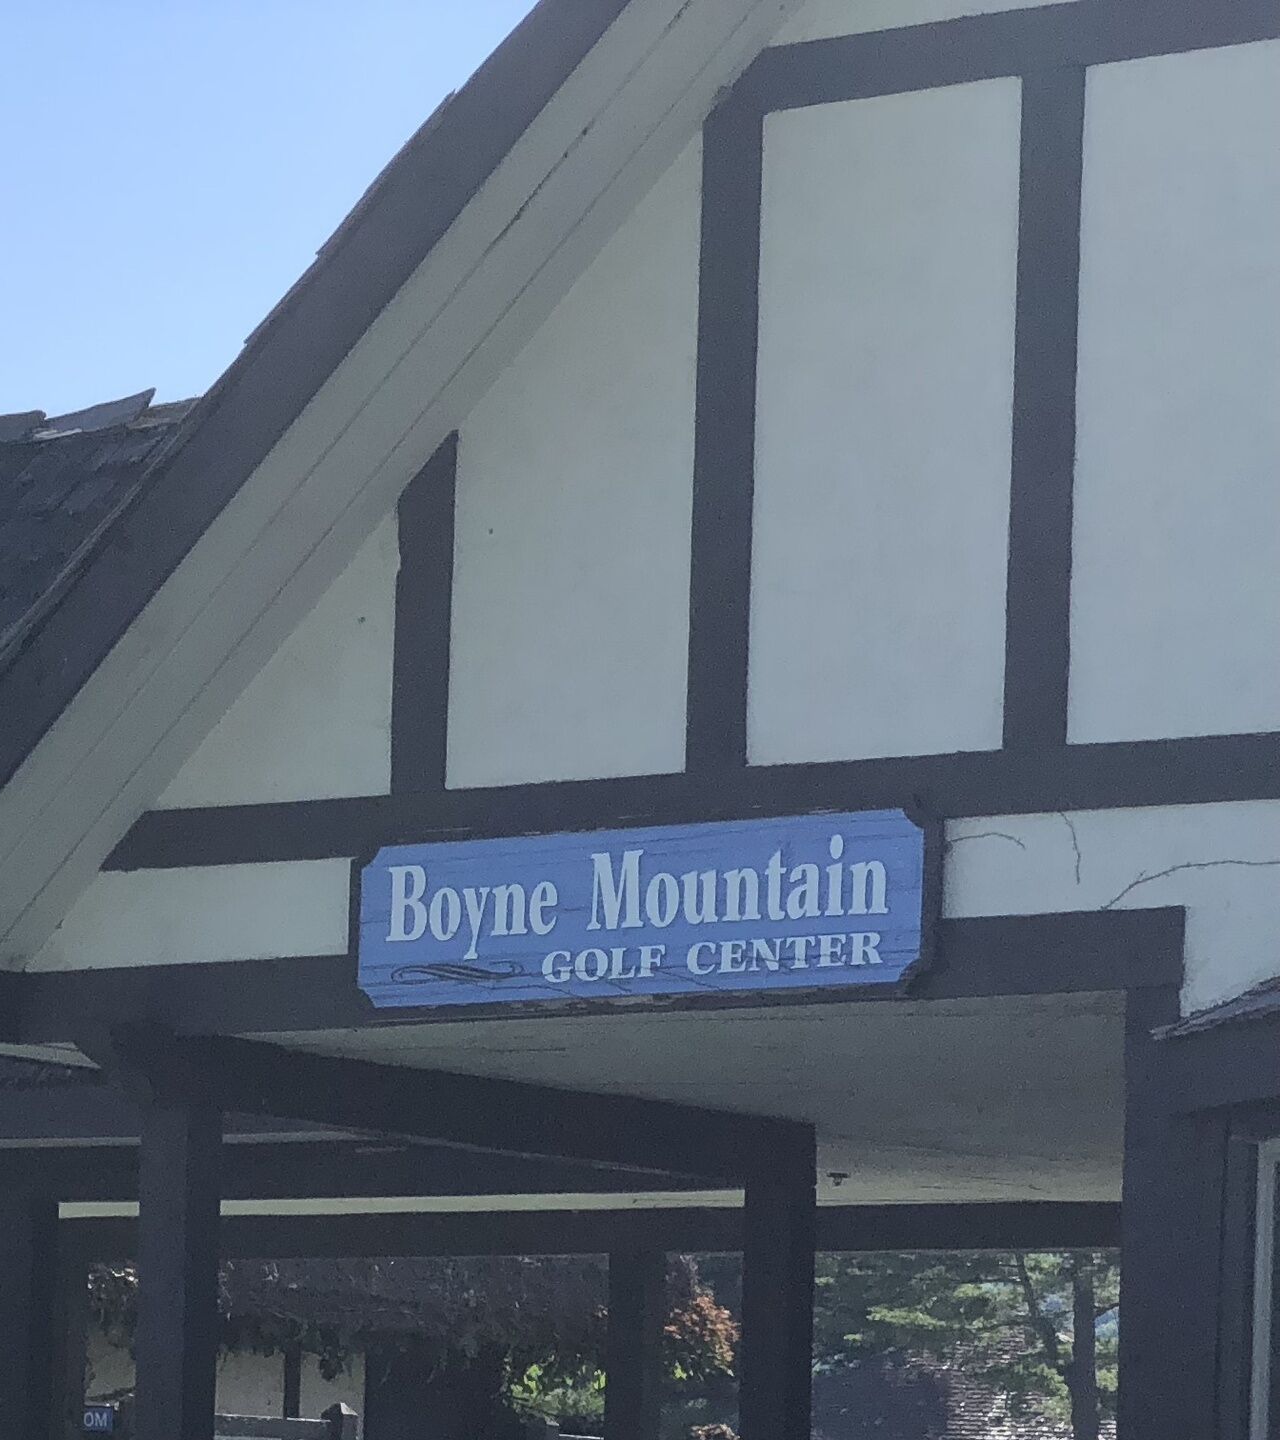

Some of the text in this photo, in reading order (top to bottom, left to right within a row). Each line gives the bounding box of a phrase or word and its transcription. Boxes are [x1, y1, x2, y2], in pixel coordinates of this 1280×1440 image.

[385, 834, 889, 960] Boyne Mountain
[541, 931, 883, 983] GOLF CENTER
